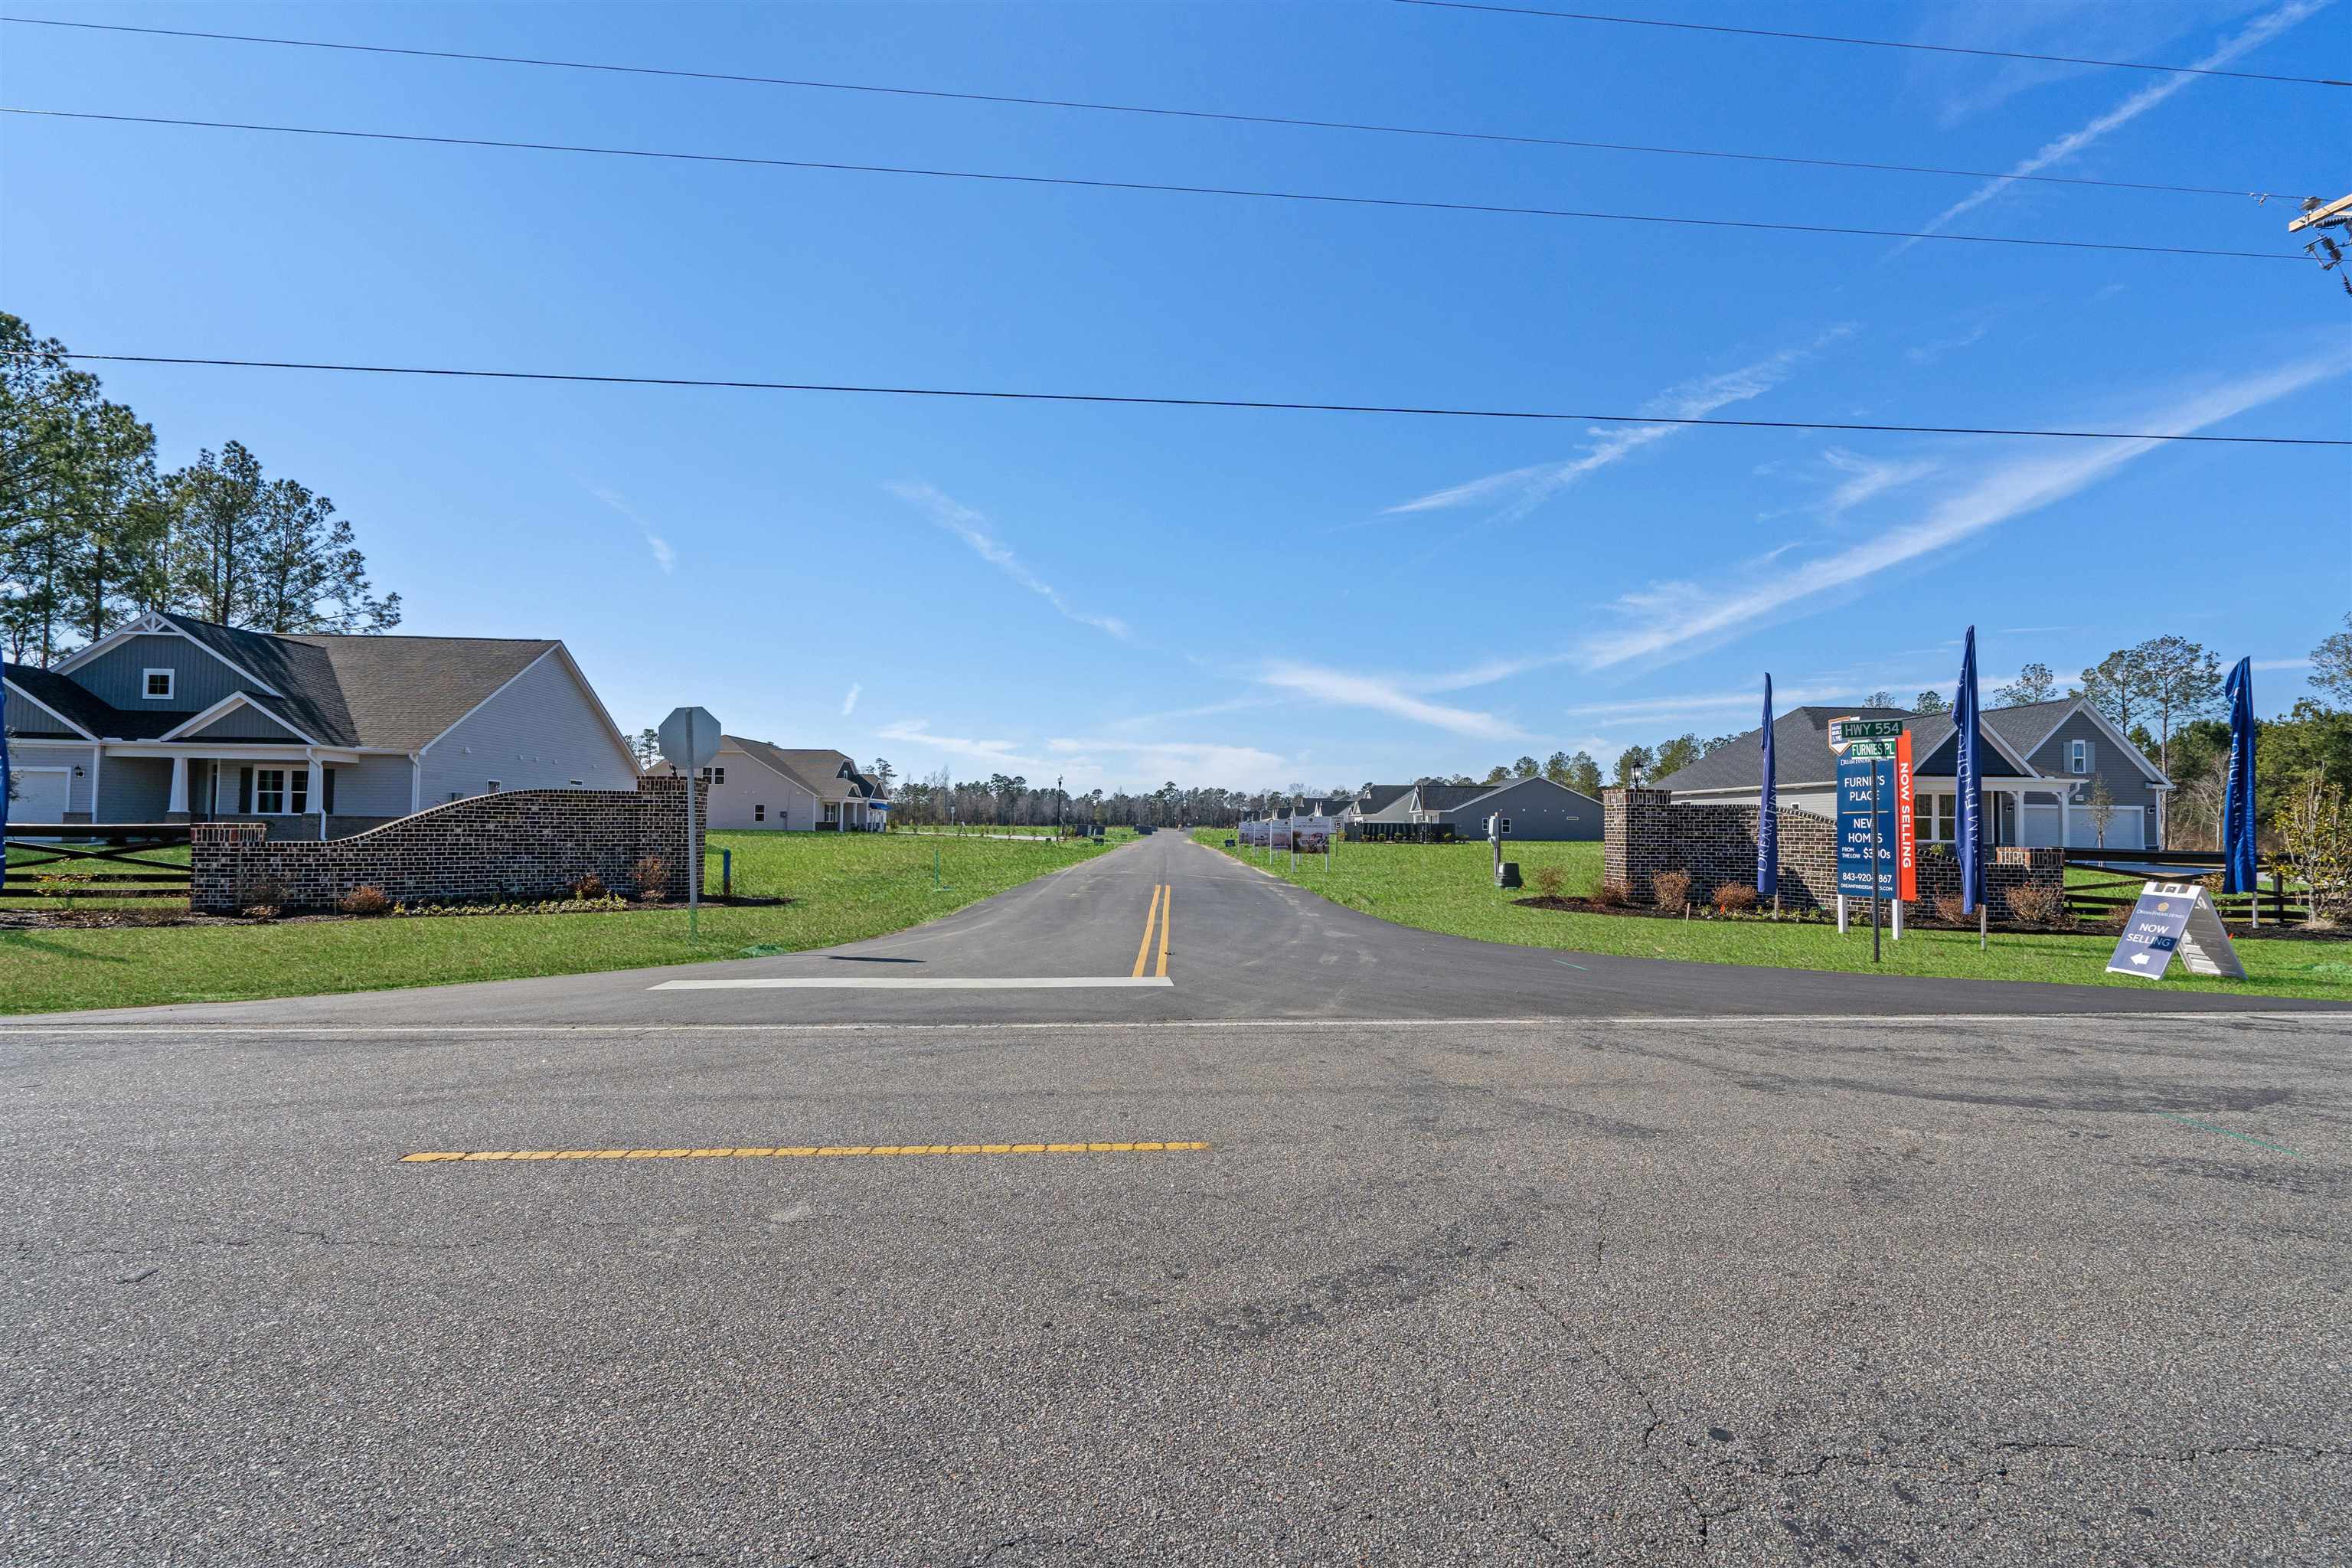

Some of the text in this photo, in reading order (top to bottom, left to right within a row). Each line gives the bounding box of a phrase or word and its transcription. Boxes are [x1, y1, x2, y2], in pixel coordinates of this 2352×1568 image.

[1845, 722, 1900, 736] HWY 554
[1852, 743, 1895, 756] FURNIES PL
[1844, 775, 1886, 788] FURNI'S
[1900, 763, 1912, 868] NOW SELLING
[1848, 832, 1883, 843] HOMS
[1757, 818, 1775, 872] DREAM
[1863, 847, 1891, 859] $30s
[1842, 872, 1893, 884] 843-920-867
[2139, 923, 2169, 934] NOW
[2126, 933, 2171, 947] SELLING
